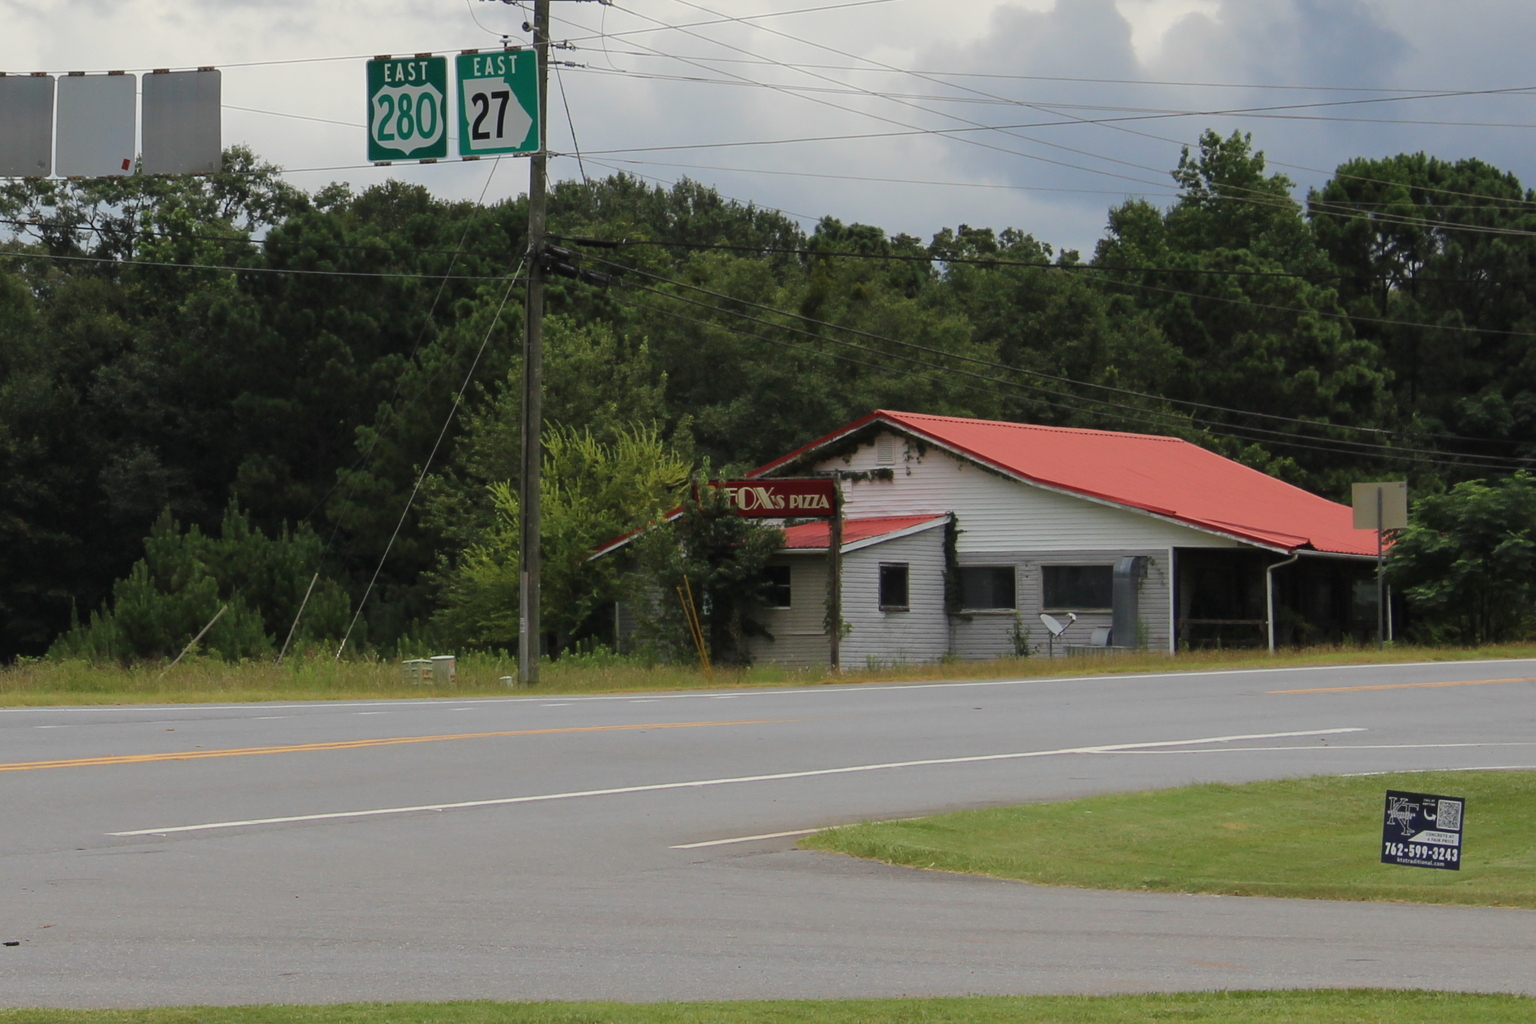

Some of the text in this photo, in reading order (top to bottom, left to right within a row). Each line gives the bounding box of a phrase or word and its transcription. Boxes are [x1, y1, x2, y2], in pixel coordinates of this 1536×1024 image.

[384, 61, 428, 83] EAST
[473, 55, 517, 77] EAST
[377, 91, 437, 142] 280
[471, 90, 510, 141] 27
[789, 494, 830, 509] PIZZA
[1385, 842, 1459, 862] 762-599-3243
